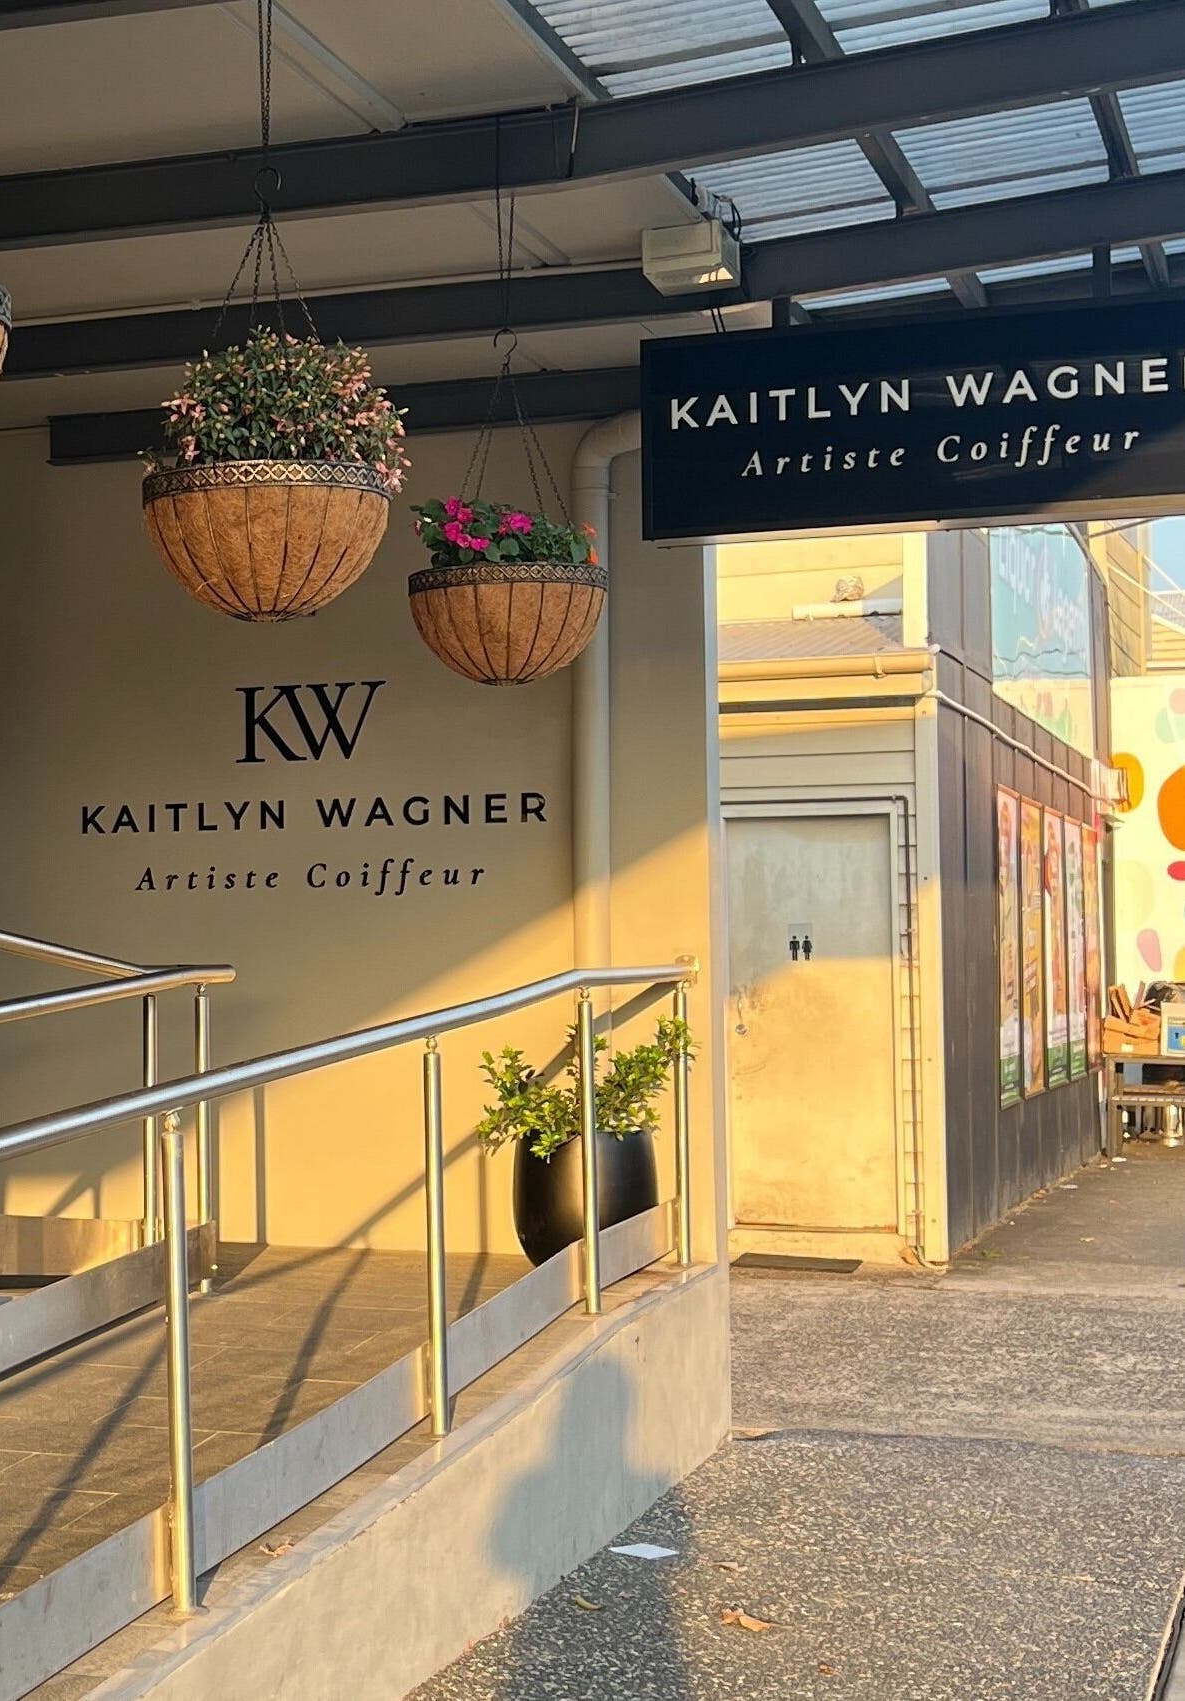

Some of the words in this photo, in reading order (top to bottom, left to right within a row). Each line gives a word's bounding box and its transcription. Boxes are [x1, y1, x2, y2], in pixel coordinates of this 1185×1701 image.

[670, 378, 911, 430] KAITLYN
[945, 357, 1185, 407] WAGNE
[740, 446, 906, 477] Artiste
[936, 424, 1141, 467] Coiffeur
[234, 680, 387, 764] KW
[80, 799, 286, 835] KAITLYN
[315, 792, 548, 828] WAGNER
[134, 866, 280, 891] Artiste
[306, 858, 486, 896] Coiffeur
